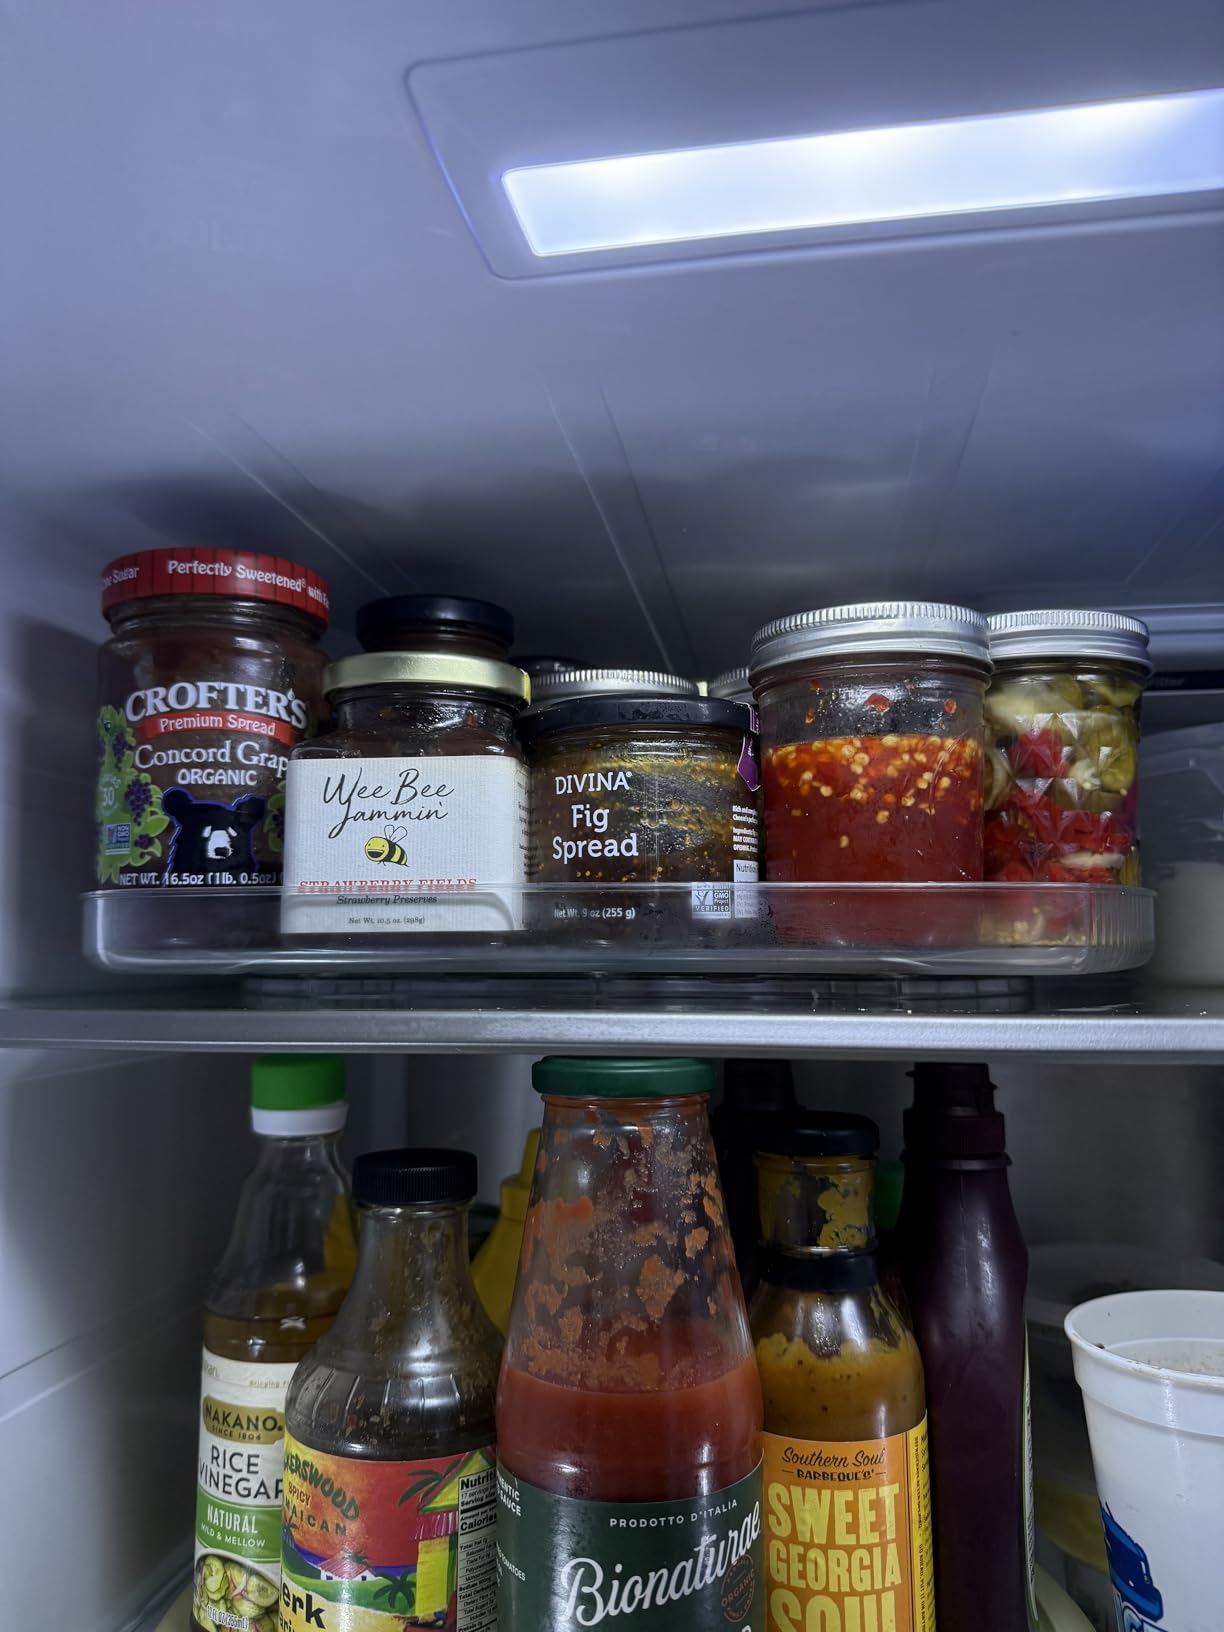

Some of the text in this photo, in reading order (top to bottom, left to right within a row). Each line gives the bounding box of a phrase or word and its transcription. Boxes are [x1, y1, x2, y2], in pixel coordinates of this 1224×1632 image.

[167, 560, 232, 576] Perfectly
[126, 682, 306, 730] CROFTER'S
[160, 714, 276, 736] Premium Spread
[134, 740, 288, 778] Concord Grap
[177, 768, 257, 785] ORGANIC
[323, 767, 455, 805] Wee Bee
[571, 804, 609, 833] Fig
[552, 833, 639, 864] Spread
[119, 874, 137, 886] NET
[140, 873, 160, 884] WT.
[297, 878, 477, 893] STRAWBERRY FIELDS
[336, 894, 438, 905] Strawberry Preserves
[582, 908, 588, 917] 9
[590, 909, 600, 918] oz
[602, 907, 623, 919] (255
[625, 907, 636, 919] g)
[212, 1424, 262, 1441] SINCE 1804
[212, 1444, 260, 1474] RICE
[782, 1446, 886, 1468] Southern Soul
[284, 1452, 359, 1521] KERSWOOD
[288, 1481, 311, 1505] SPICY
[460, 1469, 497, 1490] Nutriti
[497, 1471, 520, 1501] ENTIC
[500, 1489, 521, 1516] SAUCE
[610, 1499, 738, 1528] PRODOTTO D'ITALIA
[767, 1482, 899, 1545] SWEET
[207, 1504, 258, 1534] NATURAL
[201, 1522, 266, 1548] MILD & MELLOW
[561, 1501, 761, 1626] Bionaturae
[769, 1540, 902, 1593] GEORGIA
[721, 1568, 756, 1607] ORGANIC
[282, 1582, 326, 1629] erk
